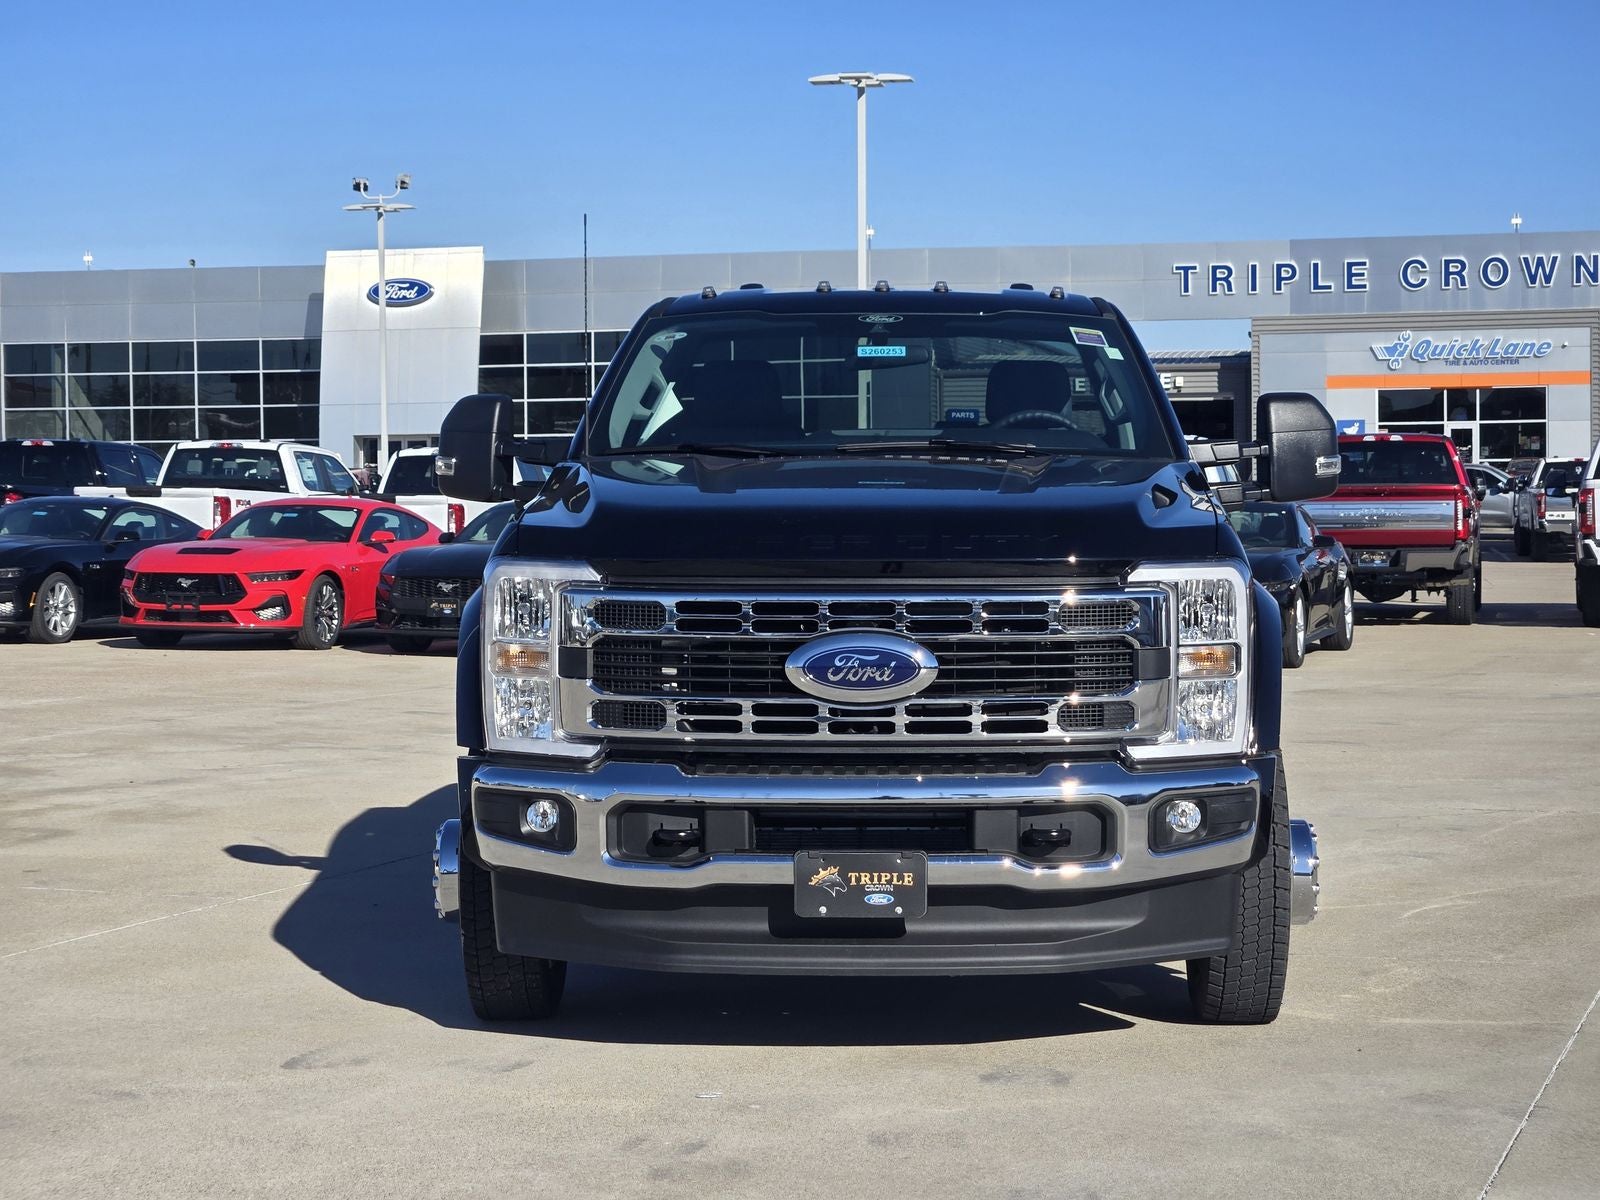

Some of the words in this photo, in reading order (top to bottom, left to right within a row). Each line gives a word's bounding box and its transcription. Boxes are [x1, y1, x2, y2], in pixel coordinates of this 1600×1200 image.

[1172, 258, 1369, 296] TRIPLE
[1400, 252, 1600, 291] CROWN
[384, 283, 419, 299] Ford
[1412, 336, 1485, 361] Quick
[1487, 337, 1552, 358] Lane
[951, 411, 975, 419] PARTS
[827, 653, 897, 682] Ford
[848, 872, 914, 886] TRIPLE
